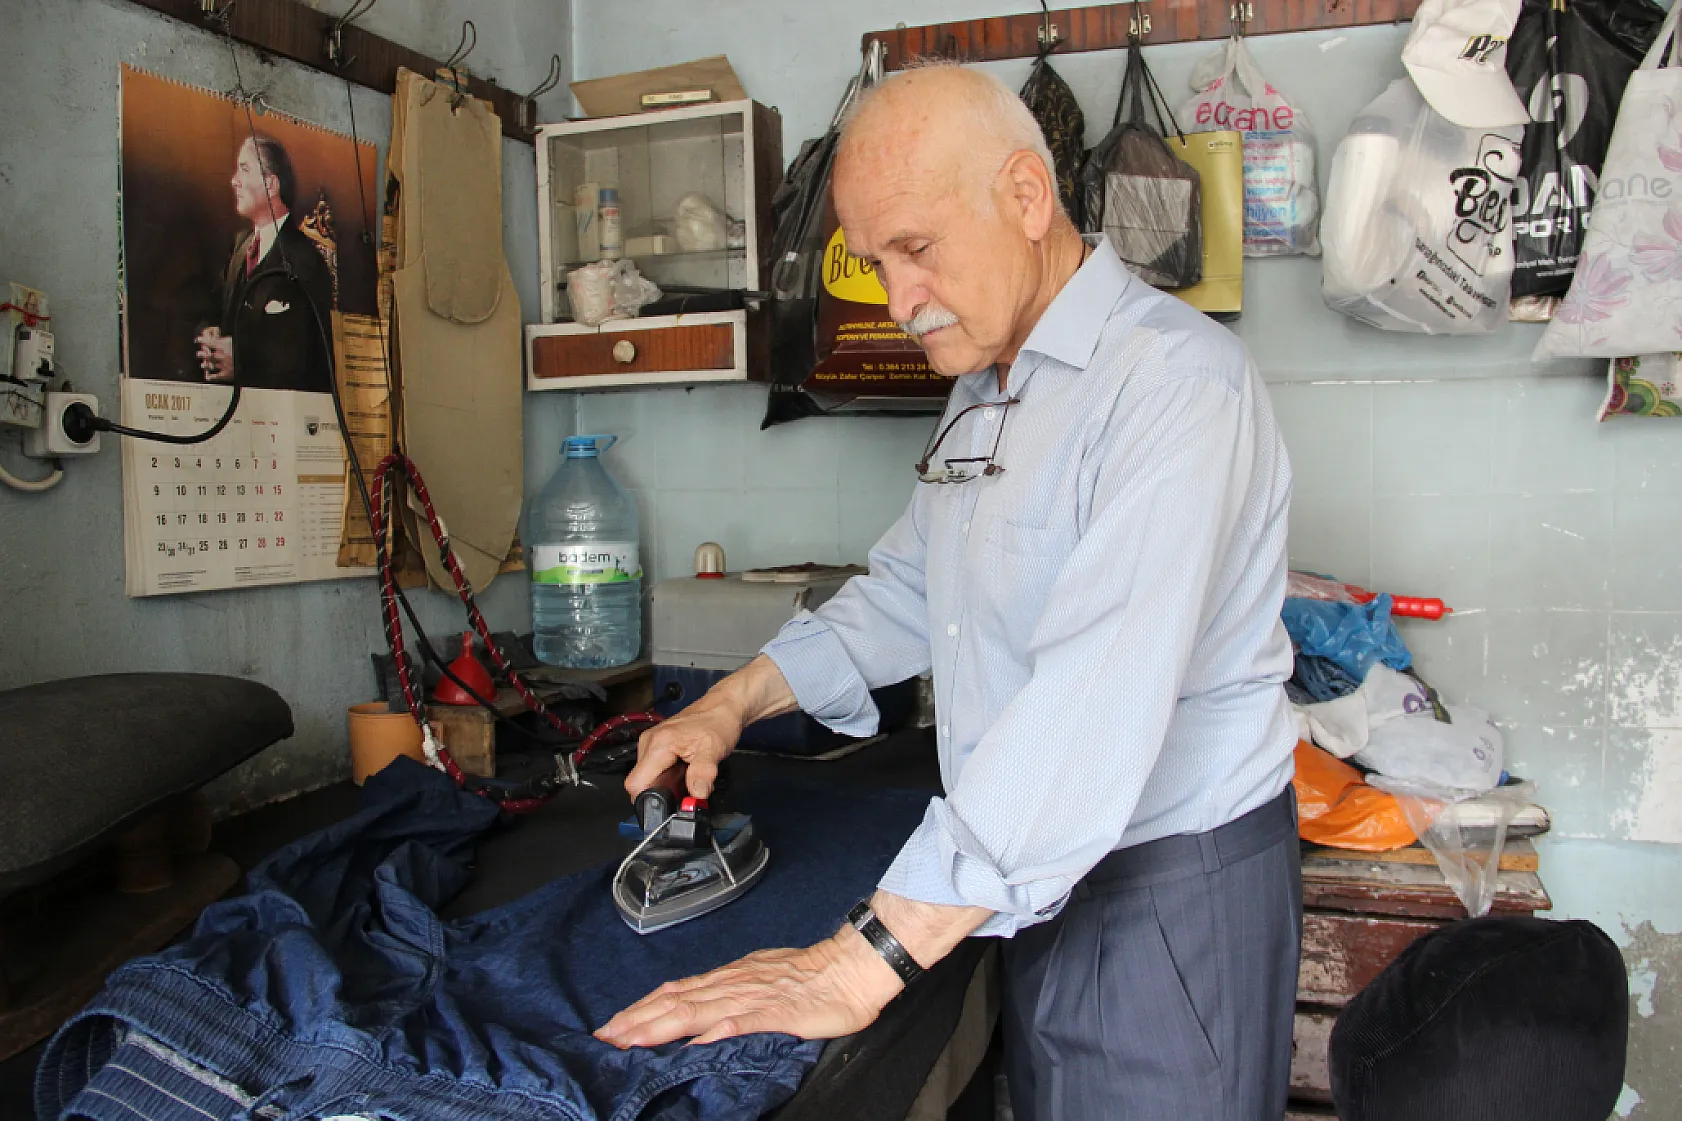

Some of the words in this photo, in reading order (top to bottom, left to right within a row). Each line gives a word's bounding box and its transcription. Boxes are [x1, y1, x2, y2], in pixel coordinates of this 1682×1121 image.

[145, 393, 169, 410] OCAK
[171, 395, 191, 411] 2017
[271, 433, 276, 444] 1
[151, 457, 158, 468] 2
[174, 458, 181, 468] 3
[195, 458, 202, 468] 4
[215, 459, 221, 469] 5
[235, 459, 240, 469] 6
[253, 459, 259, 469] 7
[272, 459, 277, 469] 8
[153, 485, 160, 496] 9
[176, 485, 187, 496] 10
[197, 485, 207, 496] 11
[216, 485, 226, 496] 12
[236, 485, 246, 496] 13
[255, 485, 264, 495] 14
[272, 485, 282, 495] 15
[156, 514, 167, 525] 16
[177, 514, 187, 525] 17
[198, 513, 208, 524] 18
[217, 513, 227, 523] 19
[236, 513, 246, 523] 20
[255, 512, 263, 522] 21
[274, 511, 283, 522] 22
[199, 540, 209, 551] 25
[218, 539, 228, 550] 26
[238, 539, 248, 549] 27
[257, 537, 267, 548] 28
[275, 537, 285, 547] 29
[558, 551, 611, 563] badem
